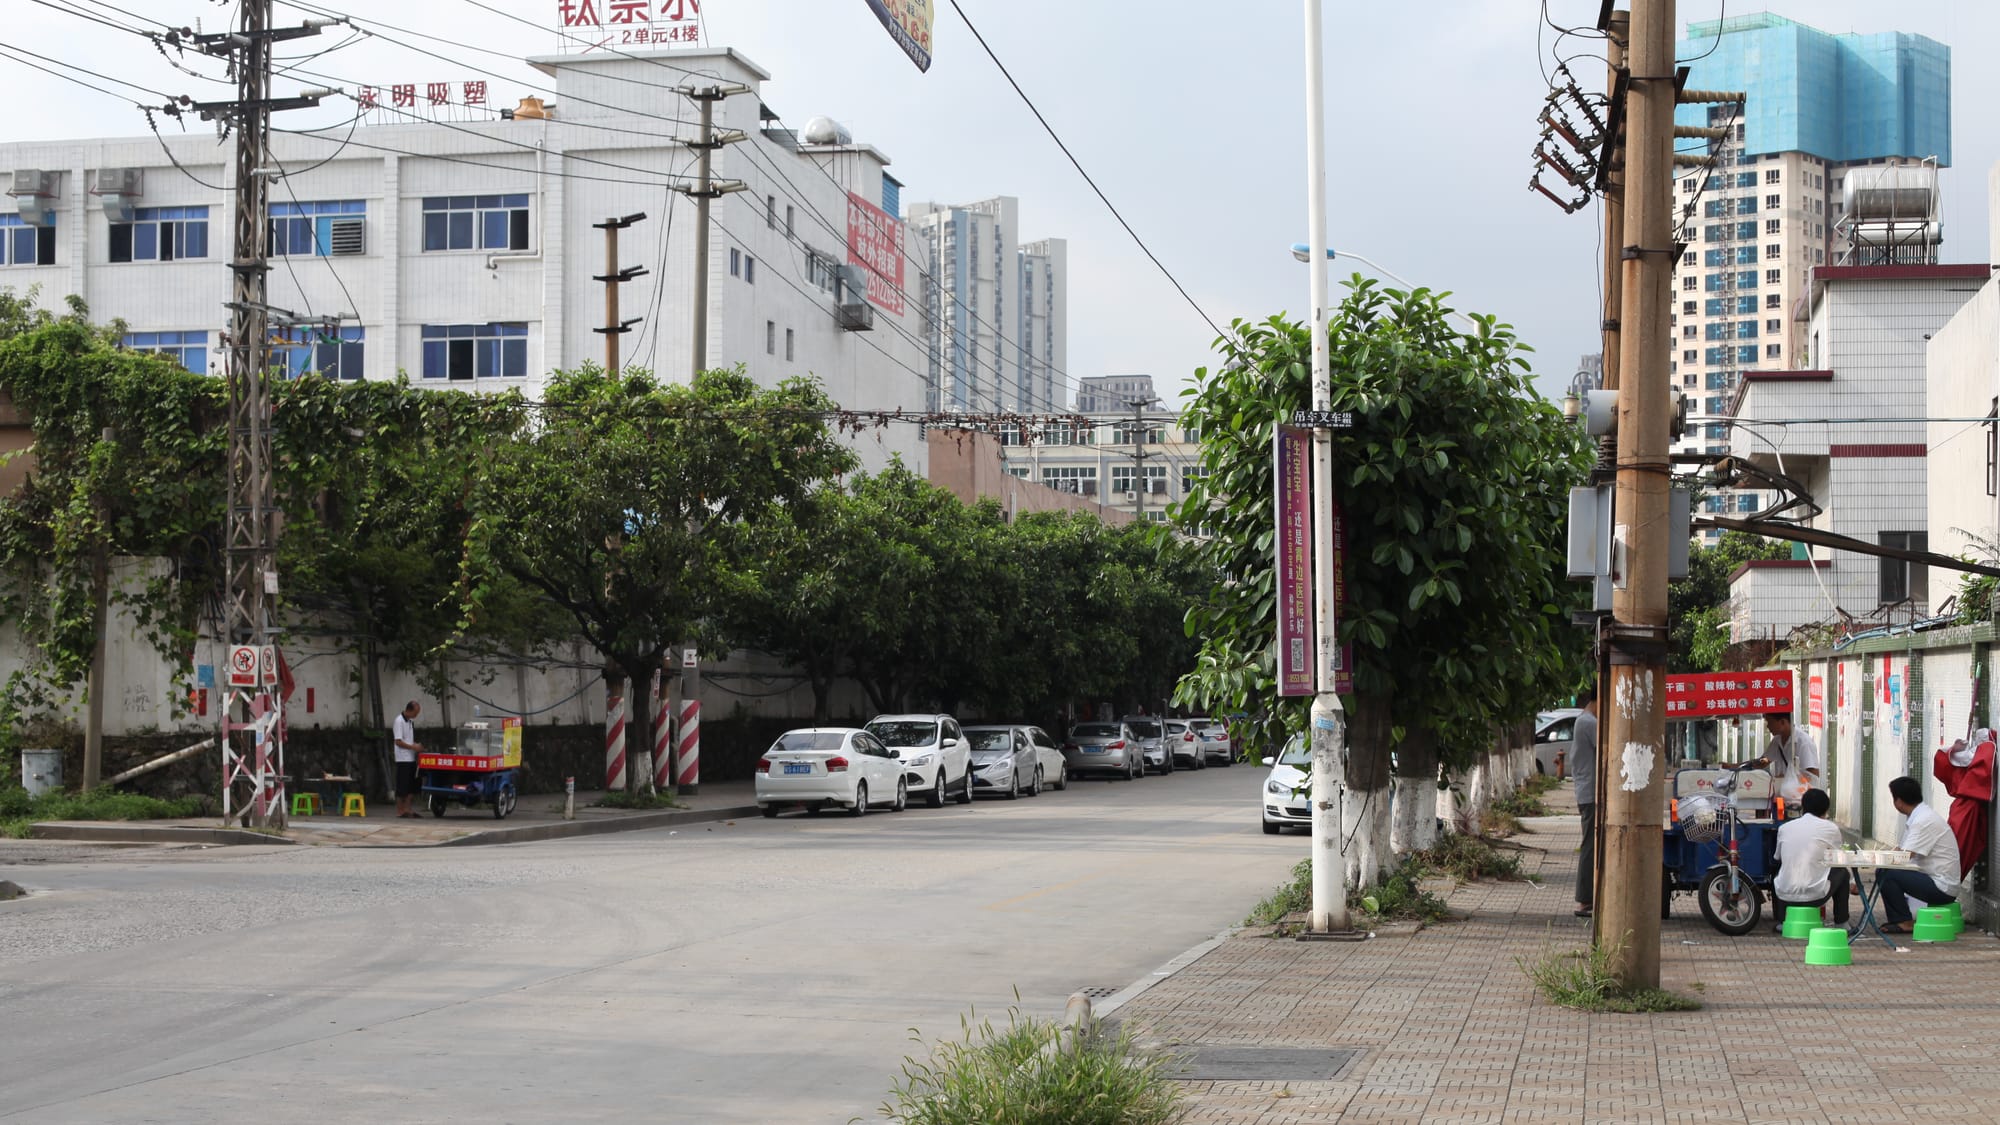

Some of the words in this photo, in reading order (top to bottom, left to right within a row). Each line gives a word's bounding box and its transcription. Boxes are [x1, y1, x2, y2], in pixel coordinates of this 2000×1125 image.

[621, 25, 699, 44] 2单元4楼
[359, 81, 486, 109] 永明吸塑
[857, 236, 896, 278] 对外招租
[1705, 680, 1736, 691] 酸辣粉
[1752, 679, 1774, 689] 凉皮
[1706, 698, 1737, 710] 珍珠粉
[1753, 697, 1776, 707] 凉面
